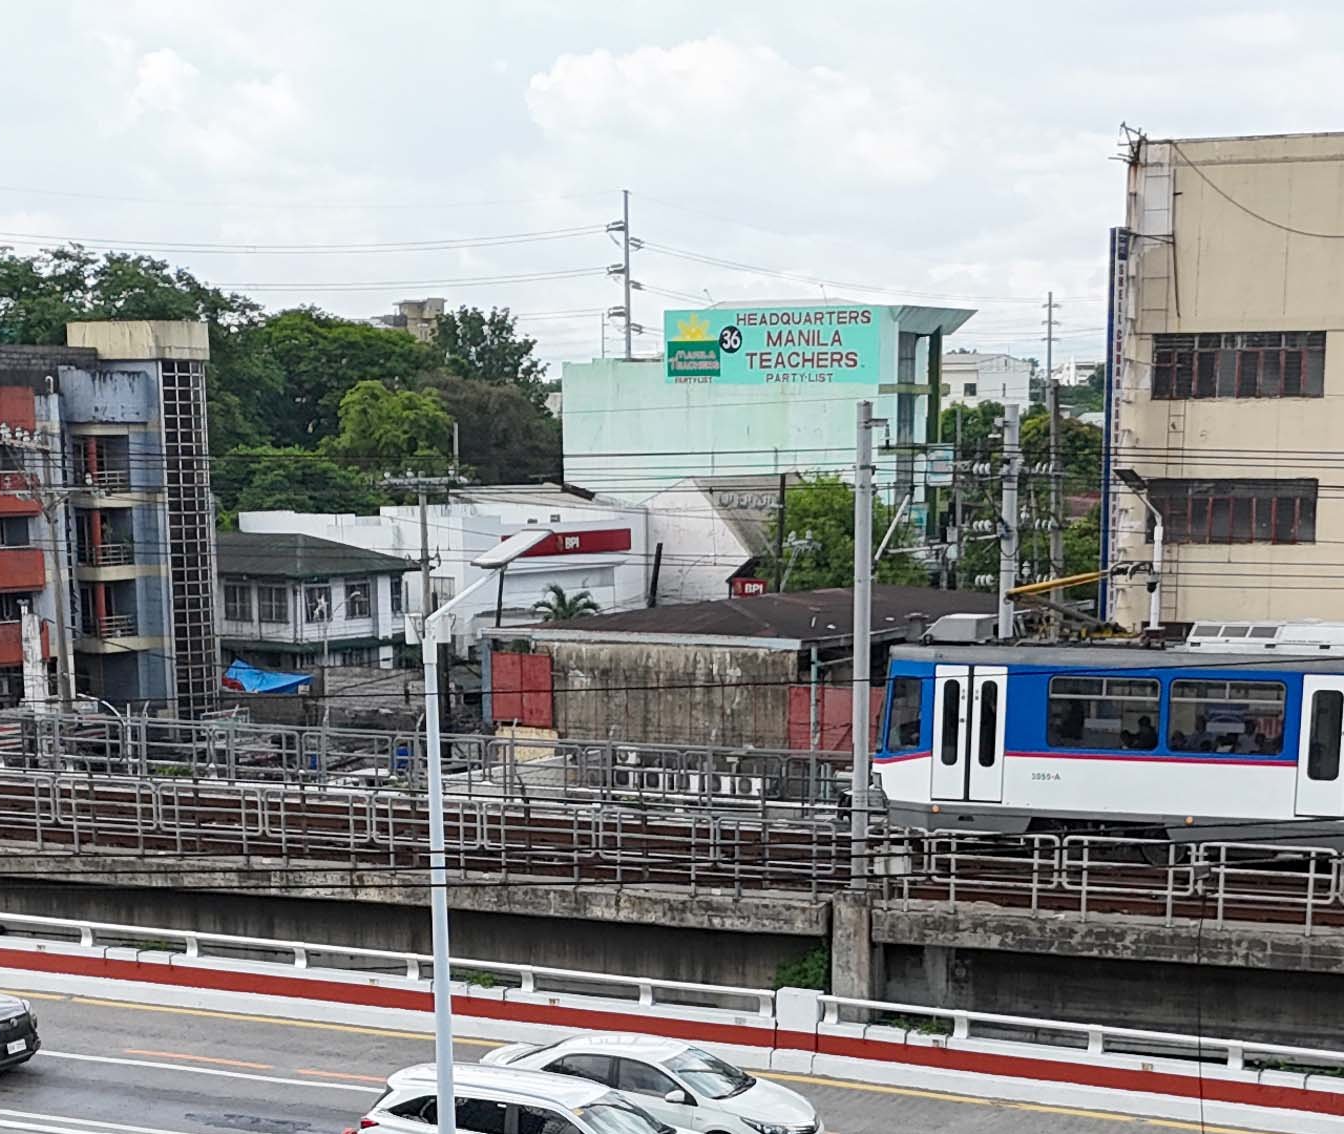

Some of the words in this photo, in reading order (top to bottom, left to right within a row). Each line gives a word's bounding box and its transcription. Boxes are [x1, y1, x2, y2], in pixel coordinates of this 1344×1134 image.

[736, 310, 872, 326] HEADQUARTERS
[721, 330, 741, 349] 36
[766, 330, 843, 347] MANILA
[745, 351, 858, 370] TEACHERS
[564, 536, 579, 549] BPI
[744, 582, 764, 594] BPI
